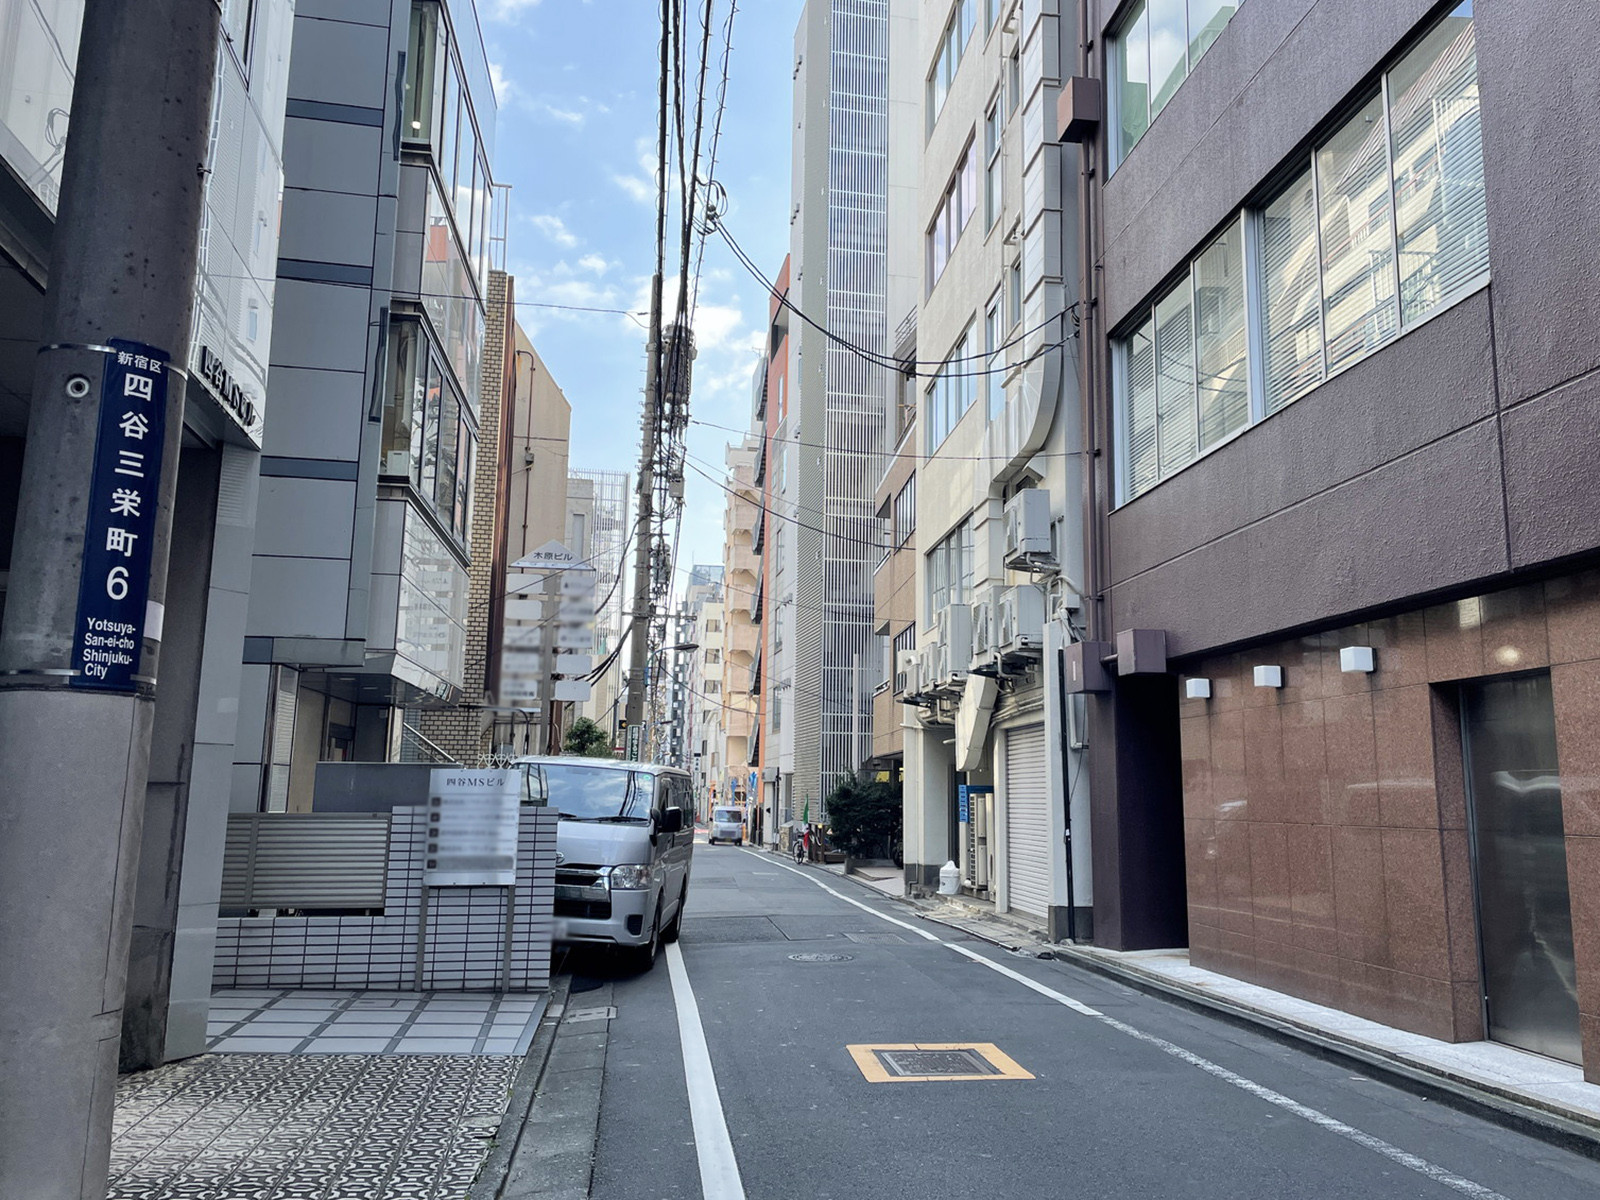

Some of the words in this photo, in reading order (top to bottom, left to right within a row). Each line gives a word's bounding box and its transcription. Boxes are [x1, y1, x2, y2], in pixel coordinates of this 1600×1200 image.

[117, 351, 163, 374] 新宿区
[533, 551, 573, 562] 木原ビル
[87, 616, 136, 636] Yotsuya-
[84, 632, 135, 650] San-ei-cho
[82, 648, 133, 666] Shinjuku-
[84, 662, 108, 680] City
[446, 777, 505, 788] 四谷MSビル
